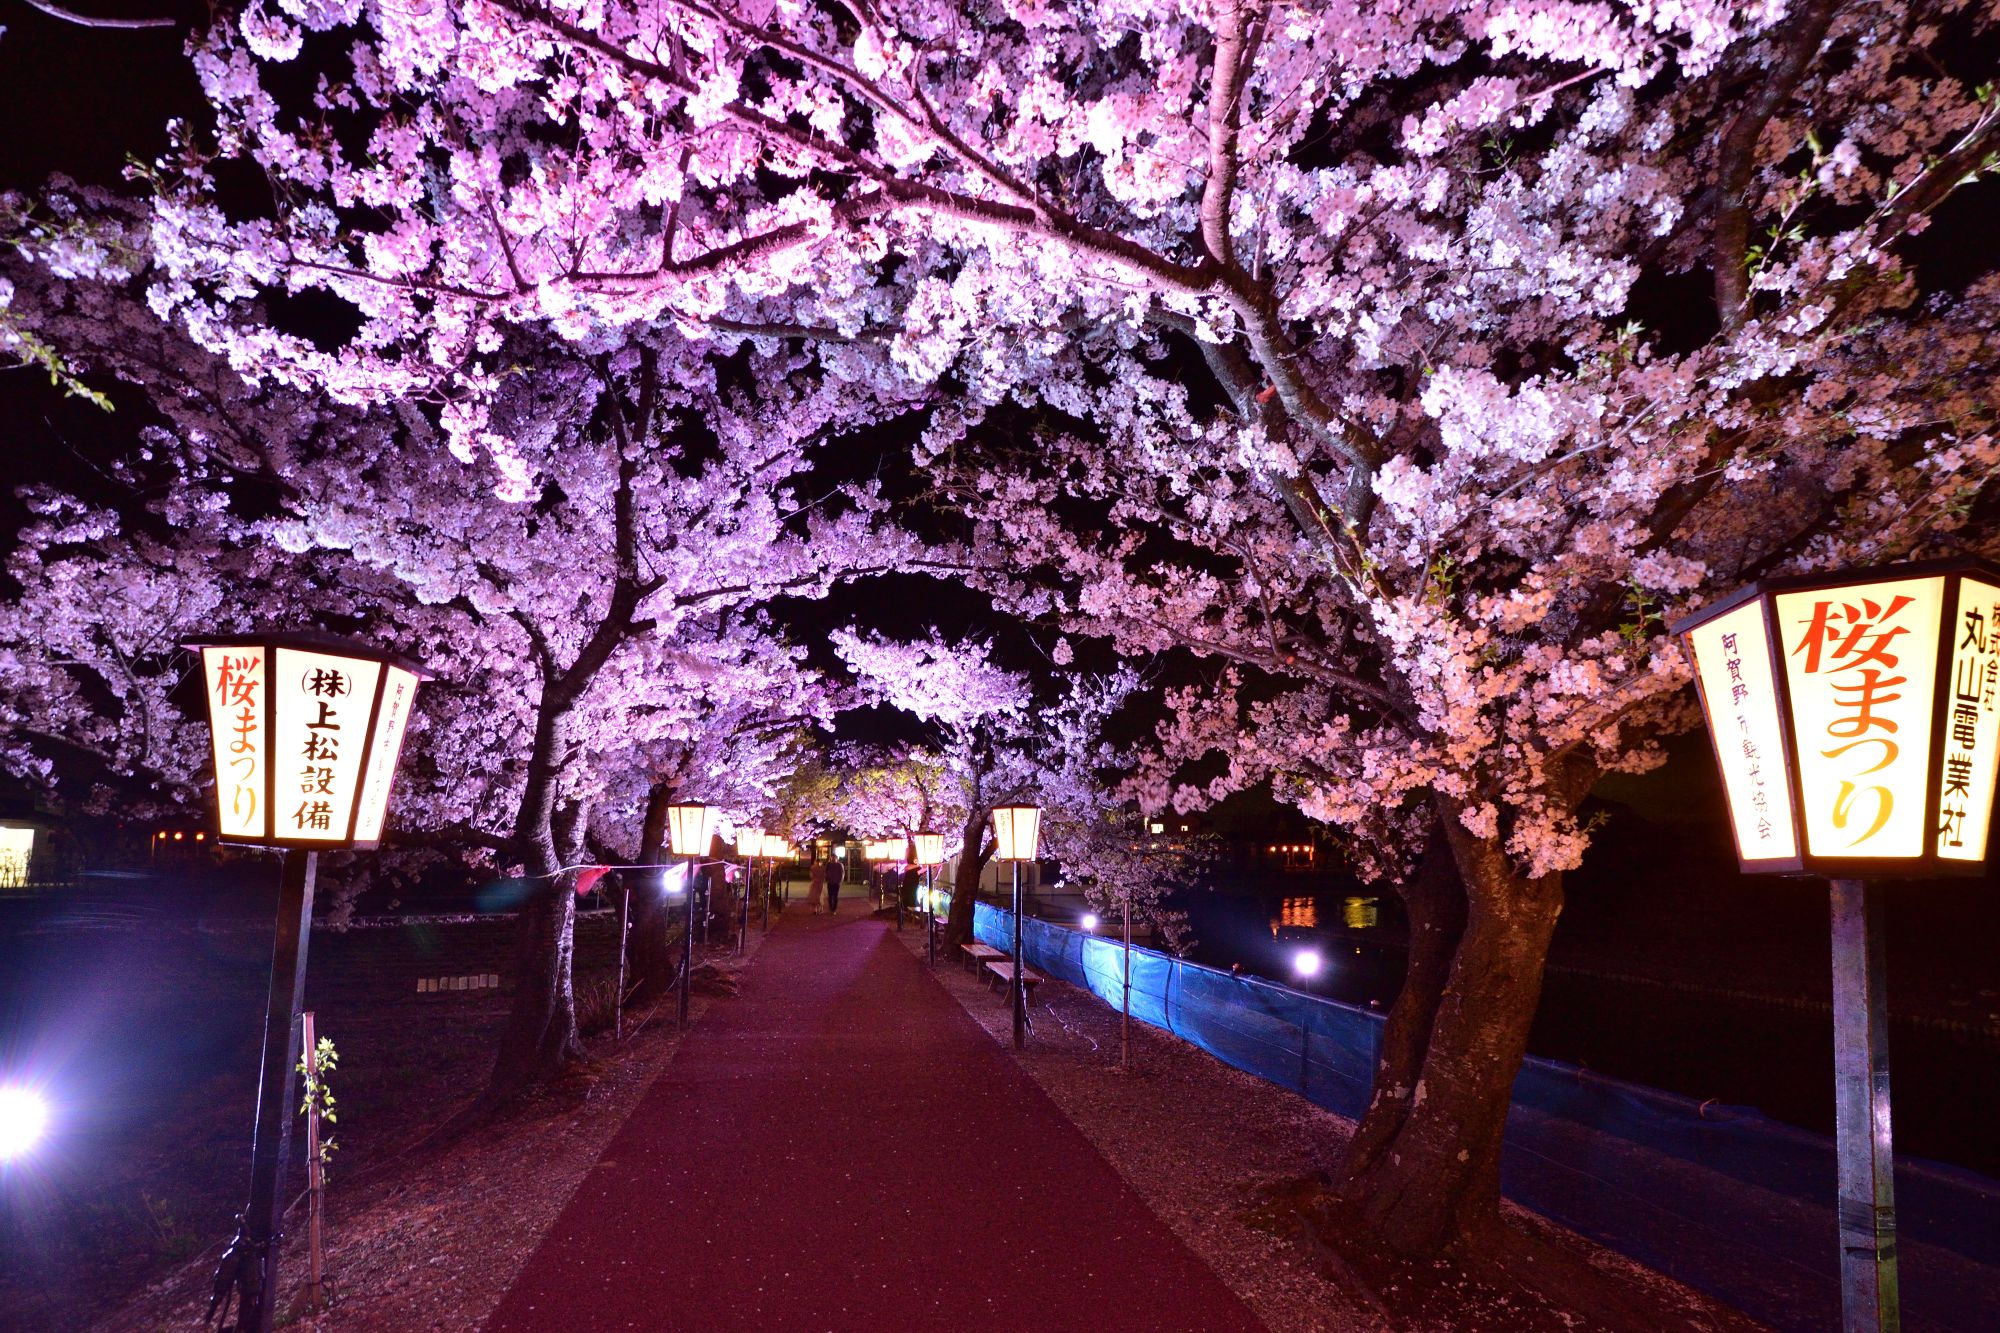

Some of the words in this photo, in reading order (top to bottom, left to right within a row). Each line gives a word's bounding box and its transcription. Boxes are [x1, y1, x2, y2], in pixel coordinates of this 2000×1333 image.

[215, 655, 261, 828] 桜まつり
[1791, 595, 1917, 848] 桜まつり
[1938, 606, 1986, 847] 丸山電業社
